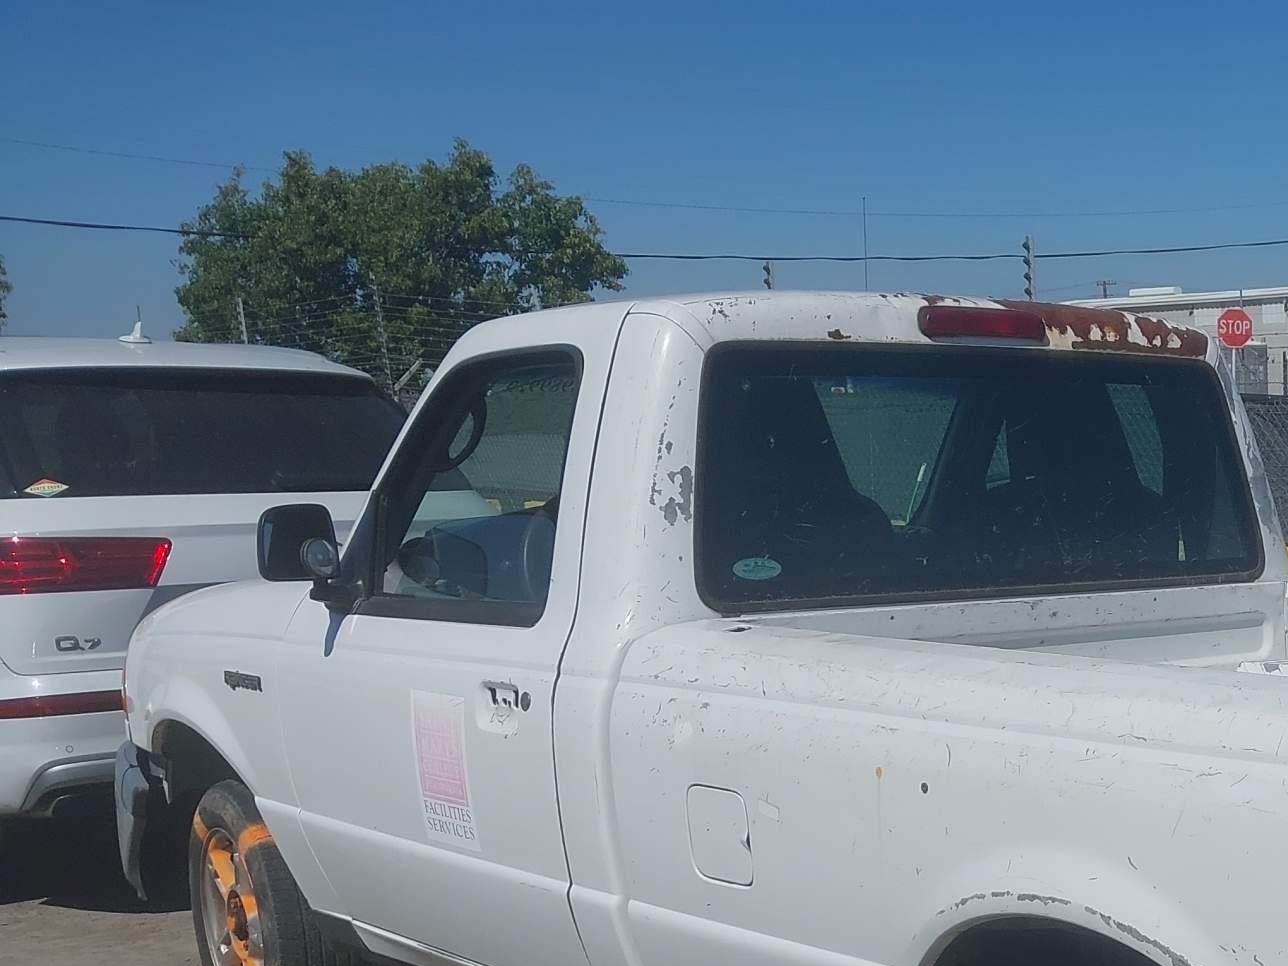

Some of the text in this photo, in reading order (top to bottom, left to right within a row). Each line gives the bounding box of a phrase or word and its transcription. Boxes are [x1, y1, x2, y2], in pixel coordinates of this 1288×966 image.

[1219, 319, 1251, 335] STOP
[54, 635, 102, 651] Q7
[424, 799, 472, 823] FACILITIES
[426, 816, 475, 841] SERVICES
